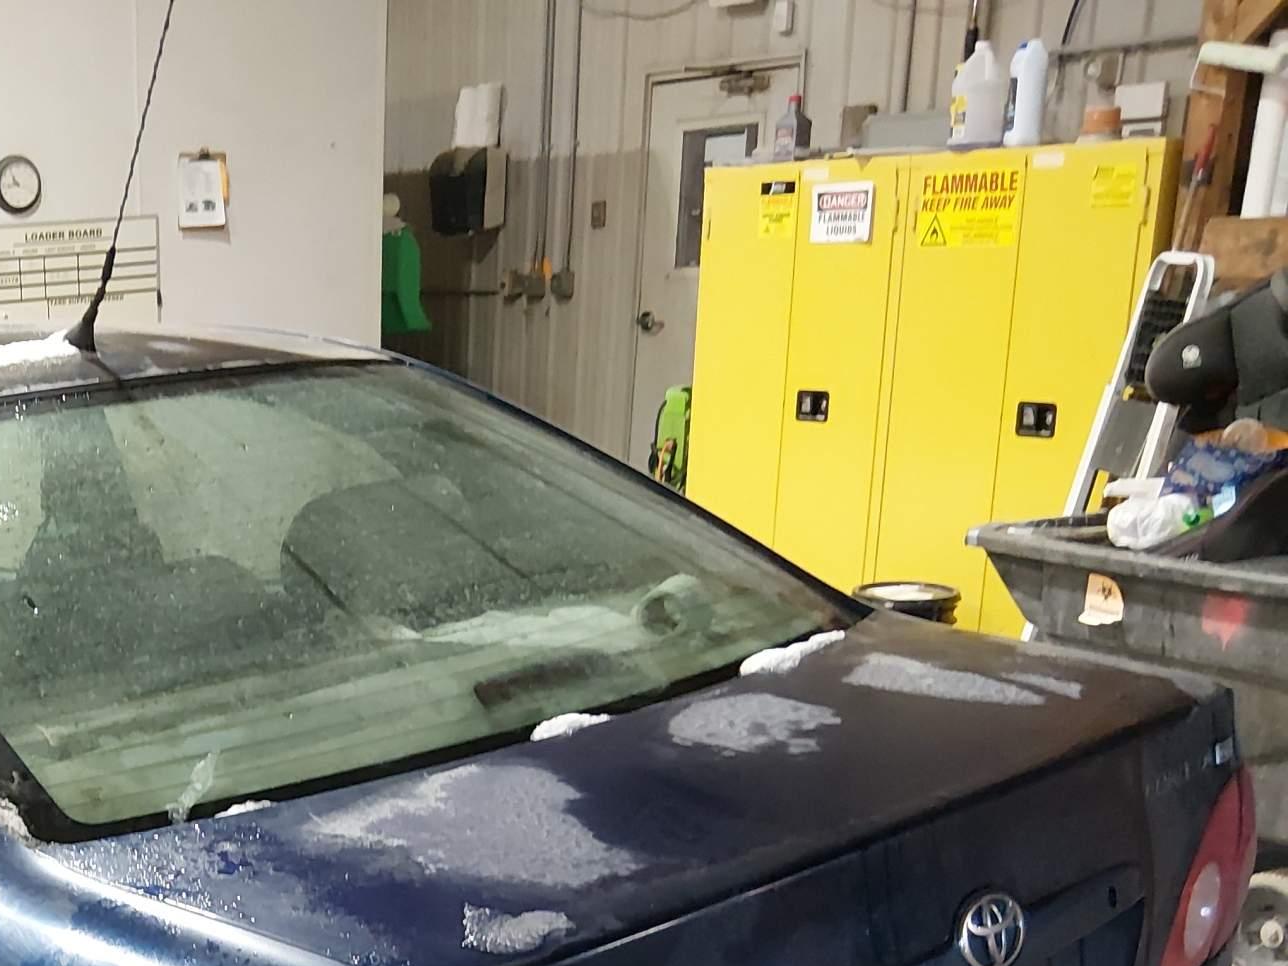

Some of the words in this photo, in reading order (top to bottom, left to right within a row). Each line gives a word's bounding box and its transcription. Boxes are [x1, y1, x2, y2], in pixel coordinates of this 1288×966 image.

[923, 170, 1019, 195] FLAMMABLE
[822, 193, 866, 210] DANGER
[922, 198, 951, 212] KEEP
[953, 196, 979, 212] FIRE
[981, 194, 1016, 210] AWAY
[818, 211, 866, 224] FLAMMABLE
[24, 231, 65, 244] LOADER
[68, 228, 103, 241] BOARD
[826, 224, 857, 235] LIQUIDS
